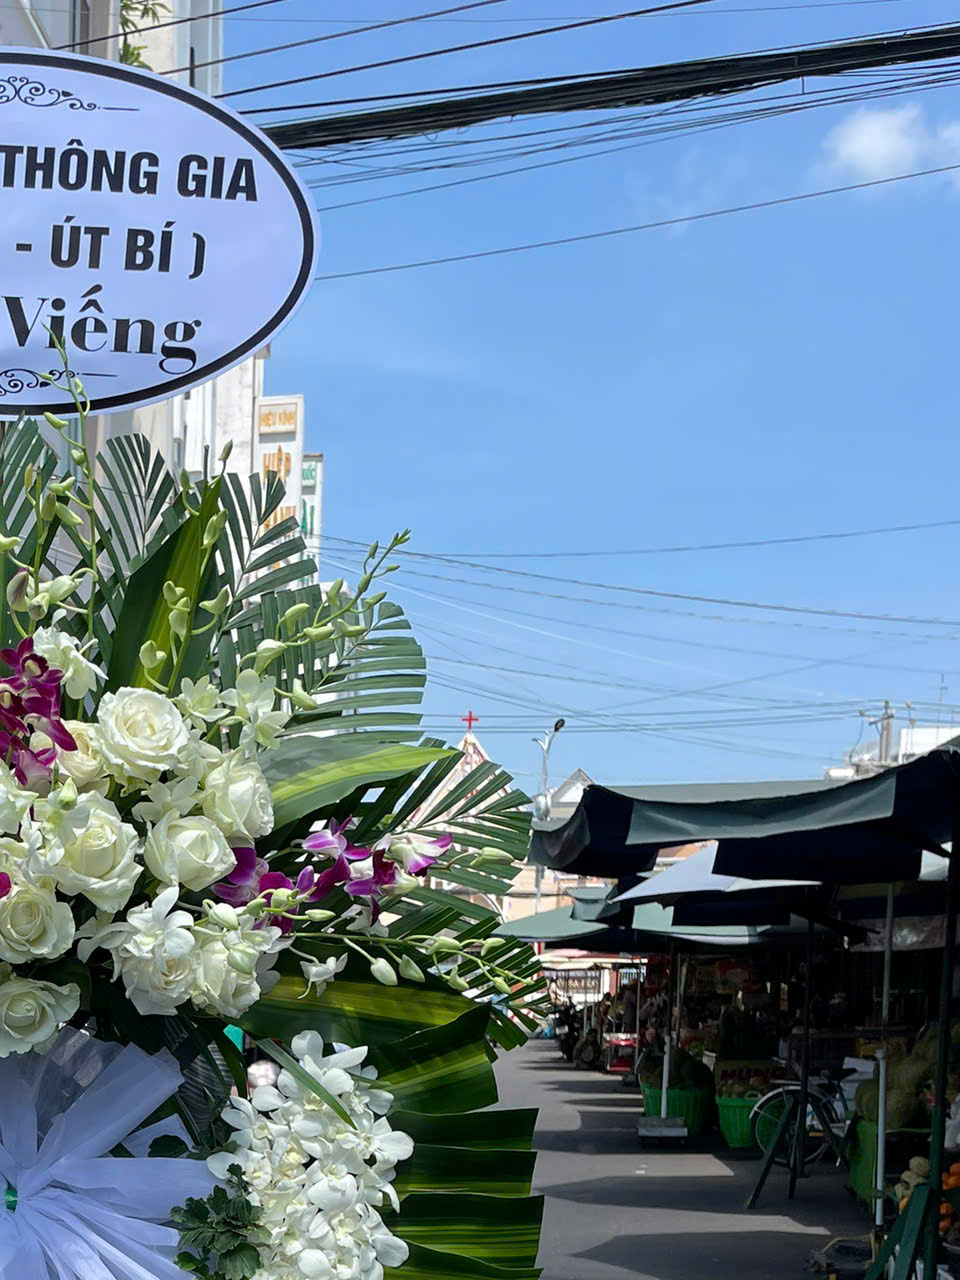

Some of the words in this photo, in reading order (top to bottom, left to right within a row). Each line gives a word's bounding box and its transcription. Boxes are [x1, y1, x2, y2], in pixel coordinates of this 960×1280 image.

[176, 153, 258, 202] GIA
[50, 215, 110, 270] ÚT
[124, 220, 173, 273] BÍ
[1, 283, 202, 376] Viếng
